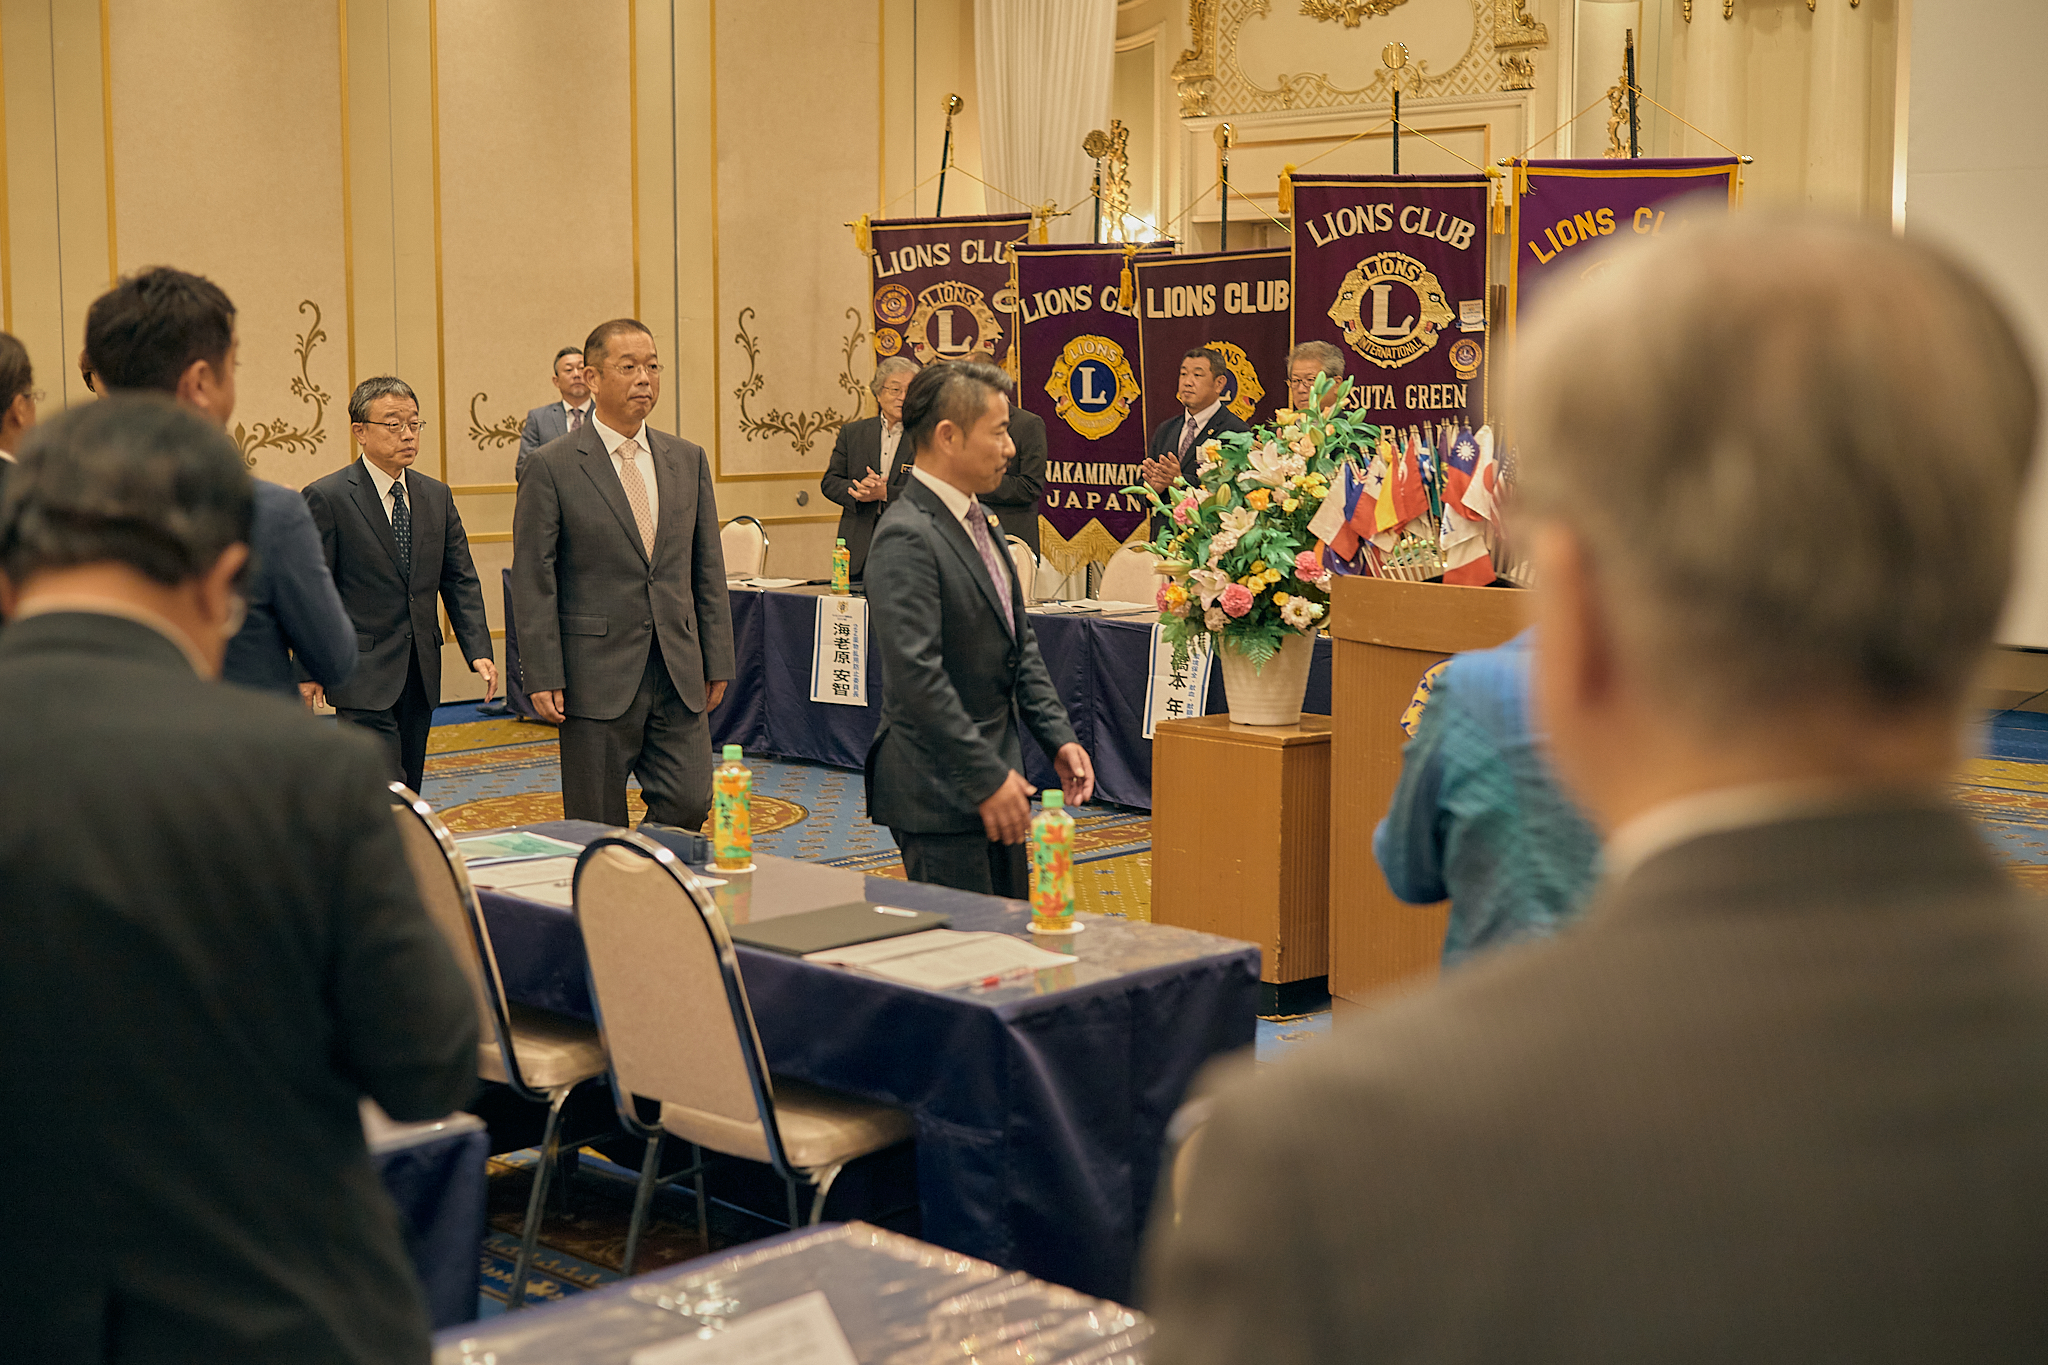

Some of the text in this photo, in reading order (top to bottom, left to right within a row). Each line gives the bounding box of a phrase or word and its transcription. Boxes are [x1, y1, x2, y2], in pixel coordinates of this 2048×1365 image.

[1305, 203, 1476, 250] LIONS CLUB
[1528, 207, 1616, 264] LIONS
[874, 243, 950, 278] LIONS
[1362, 258, 1421, 283] LIONS
[926, 285, 977, 308] LIONS
[1019, 284, 1092, 325] LIONS
[1146, 280, 1290, 318] LIONS CLUB
[1370, 285, 1415, 336] L
[936, 310, 973, 352] L
[1358, 337, 1423, 359] INTERNATIONAL
[1069, 341, 1118, 362] LIONS
[1078, 366, 1107, 404] L
[1342, 383, 1468, 410] SUTA GREEN
[1046, 489, 1141, 512] JAPAN
